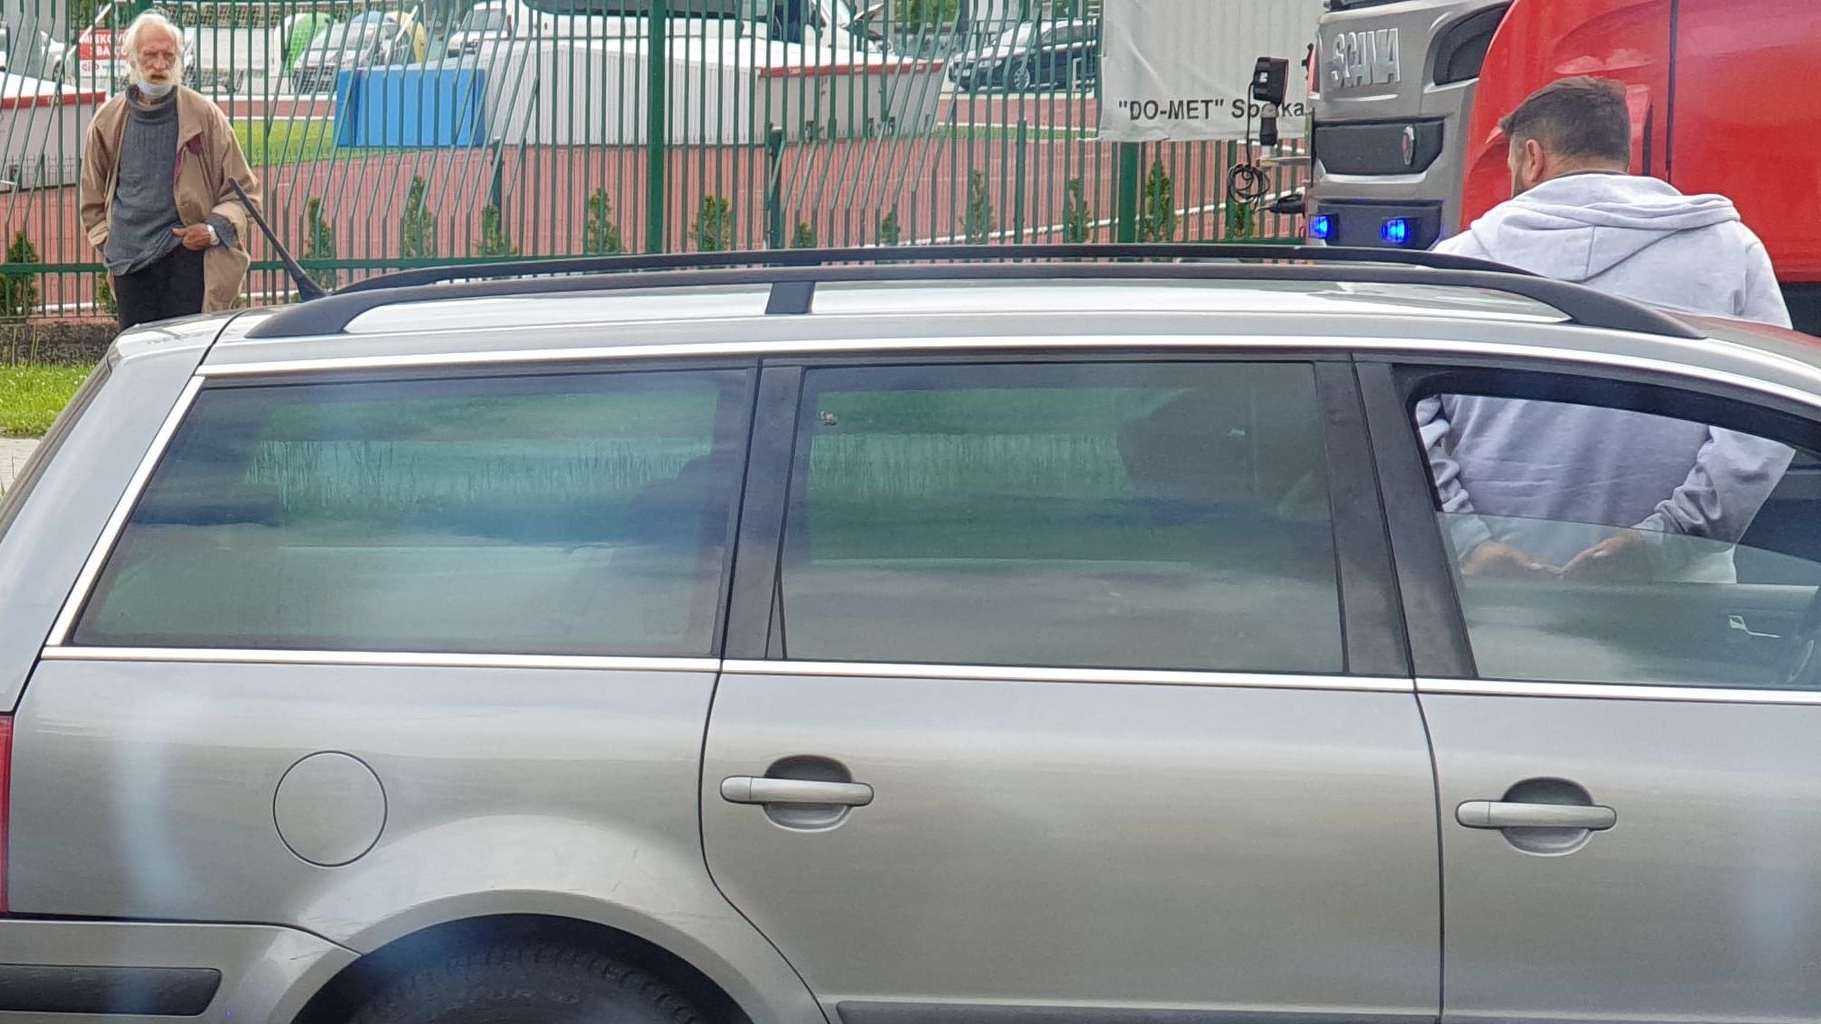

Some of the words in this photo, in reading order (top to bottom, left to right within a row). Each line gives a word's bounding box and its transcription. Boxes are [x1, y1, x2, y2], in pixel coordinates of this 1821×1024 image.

[1331, 27, 1401, 88] SCANIA
[1118, 99, 1224, 120] "DO-MET"
[1231, 99, 1305, 121] Spka
